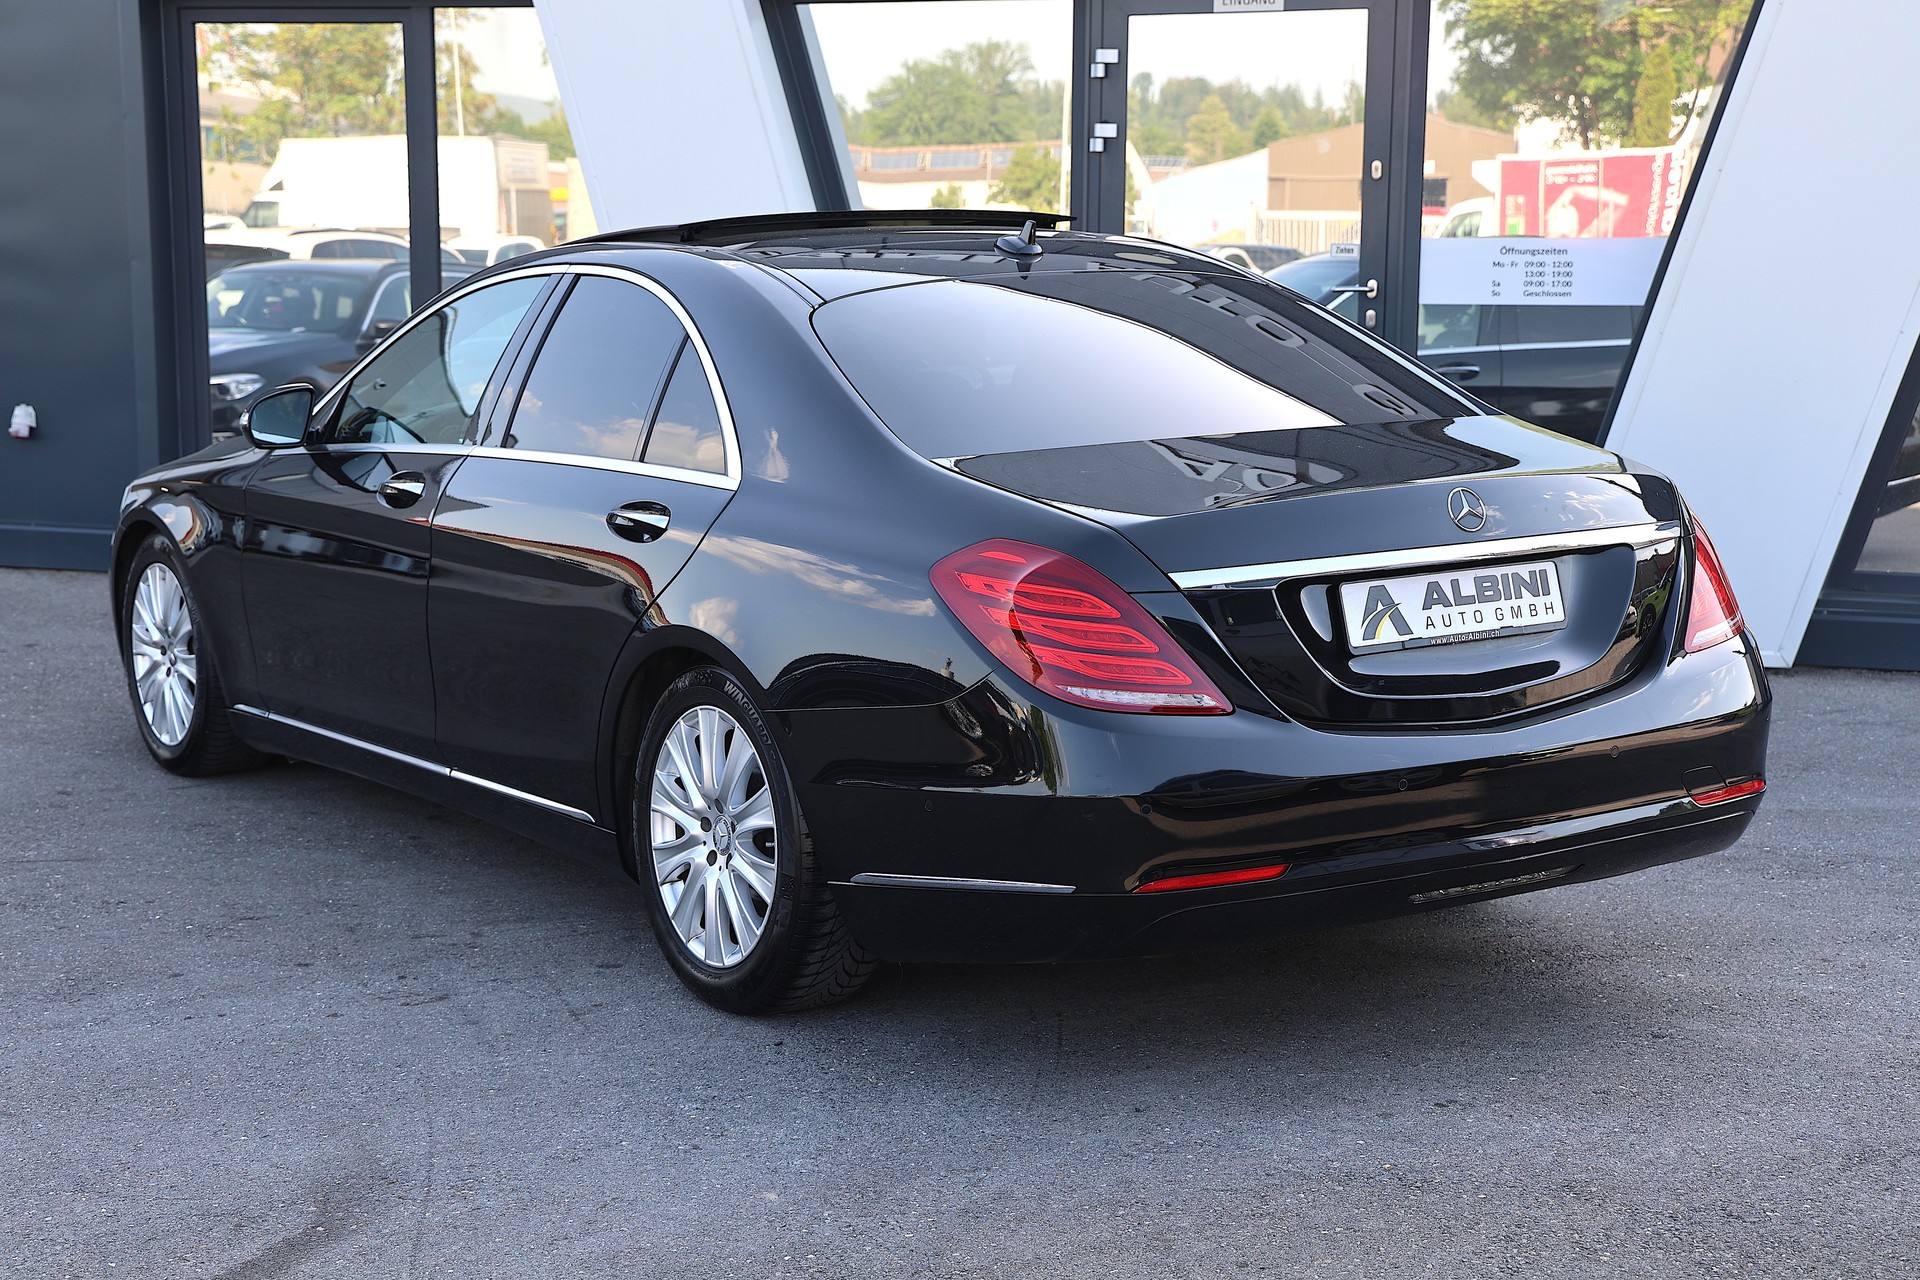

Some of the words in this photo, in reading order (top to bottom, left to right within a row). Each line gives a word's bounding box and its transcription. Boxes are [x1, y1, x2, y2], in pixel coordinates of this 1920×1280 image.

[1499, 246, 1568, 257] Öffnungszeiten
[1524, 261, 1546, 269] 09:00
[1552, 261, 1574, 269] 12:00
[1523, 280, 1545, 288] 09:00
[1551, 280, 1573, 288] 17:00
[1522, 290, 1572, 298] Geschlossen
[1422, 568, 1551, 611] ALBINI
[1425, 609, 1484, 630] AUTO
[1495, 601, 1555, 622] GMBH
[1430, 629, 1500, 645] www.Auto-Albini.ch
[723, 680, 773, 746] WINGUARD
